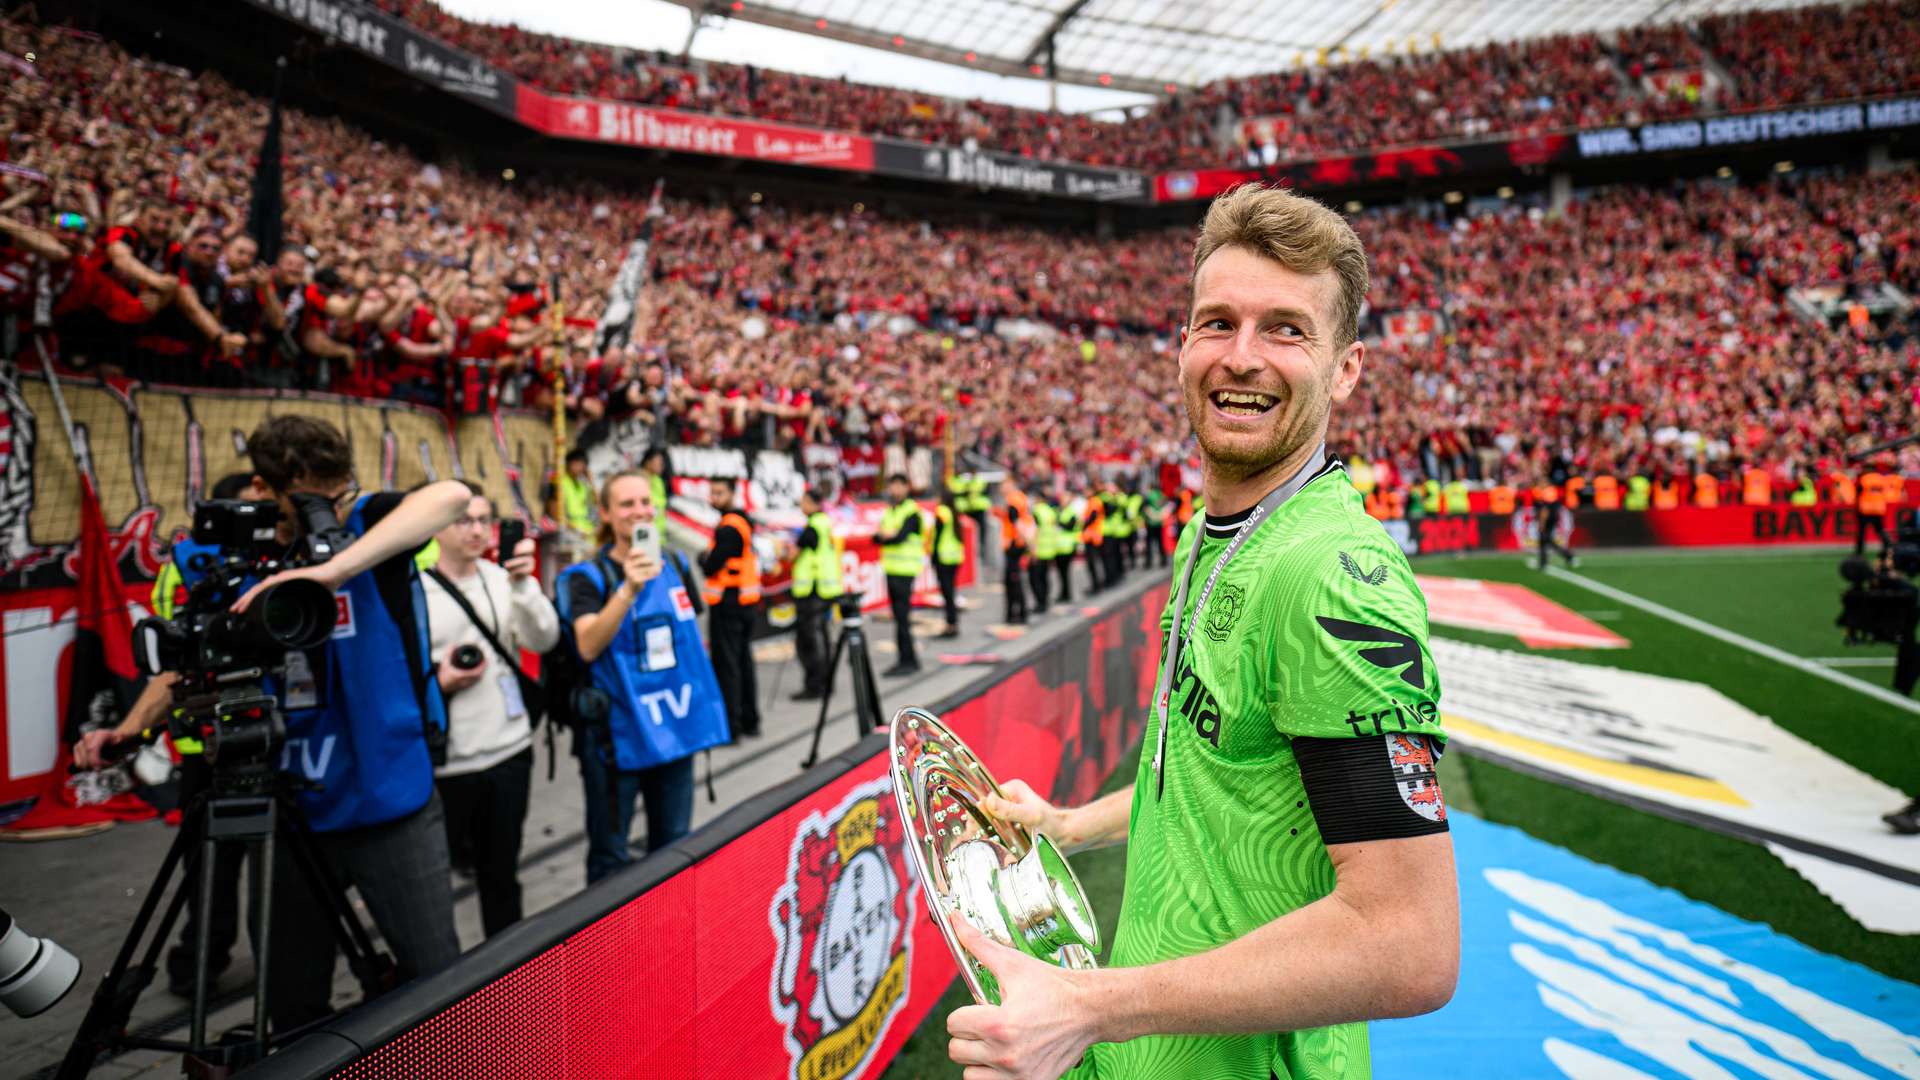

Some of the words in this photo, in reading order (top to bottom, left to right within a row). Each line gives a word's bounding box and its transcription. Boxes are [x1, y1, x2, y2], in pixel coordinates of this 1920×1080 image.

[266, 0, 388, 56] burger
[599, 104, 737, 154] Bitburger
[1640, 120, 1702, 151] SIND
[1705, 105, 1863, 145] DEUTSCHER
[949, 149, 1054, 192] Bitburger
[1240, 505, 1265, 534] 2024
[1419, 517, 1481, 553] 2024
[1755, 509, 1863, 537] BAYE
[640, 683, 693, 726] TV
[1345, 698, 1438, 737] trive
[280, 734, 338, 780] TV
